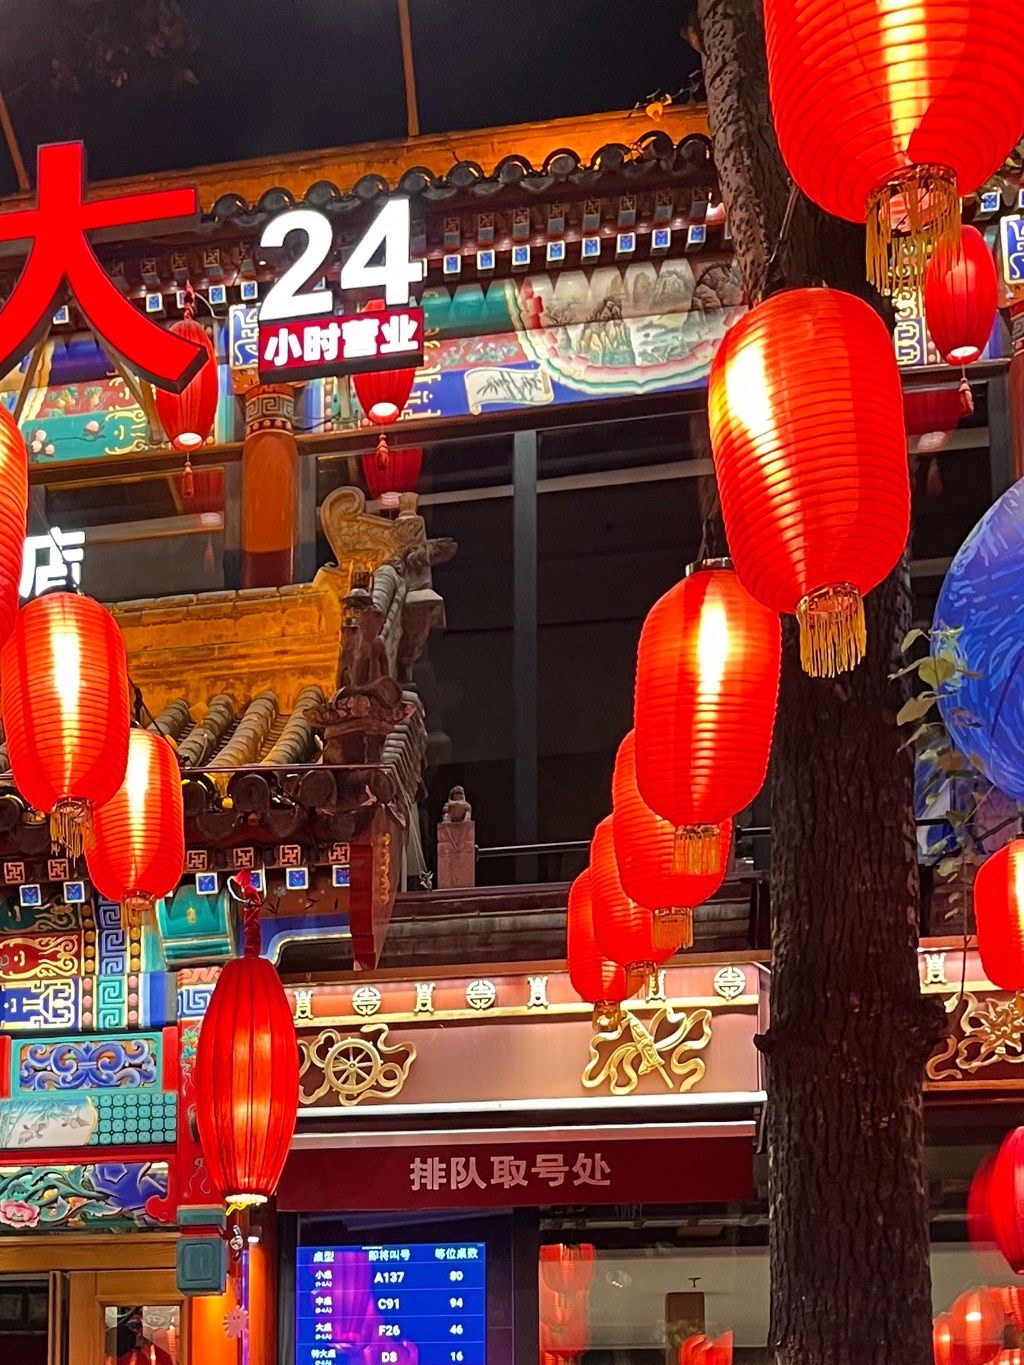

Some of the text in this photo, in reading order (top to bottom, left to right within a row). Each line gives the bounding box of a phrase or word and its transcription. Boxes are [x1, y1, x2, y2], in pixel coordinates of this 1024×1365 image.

[258, 197, 425, 320] 24
[264, 313, 420, 362] 小时营业
[409, 1153, 612, 1191] 排队取号处
[374, 1272, 404, 1283] A137
[378, 1299, 399, 1309] C91
[450, 1298, 463, 1308] 94
[378, 1325, 400, 1336] F26
[450, 1324, 463, 1335] 46
[381, 1352, 398, 1362] D8
[450, 1351, 463, 1362] 16
